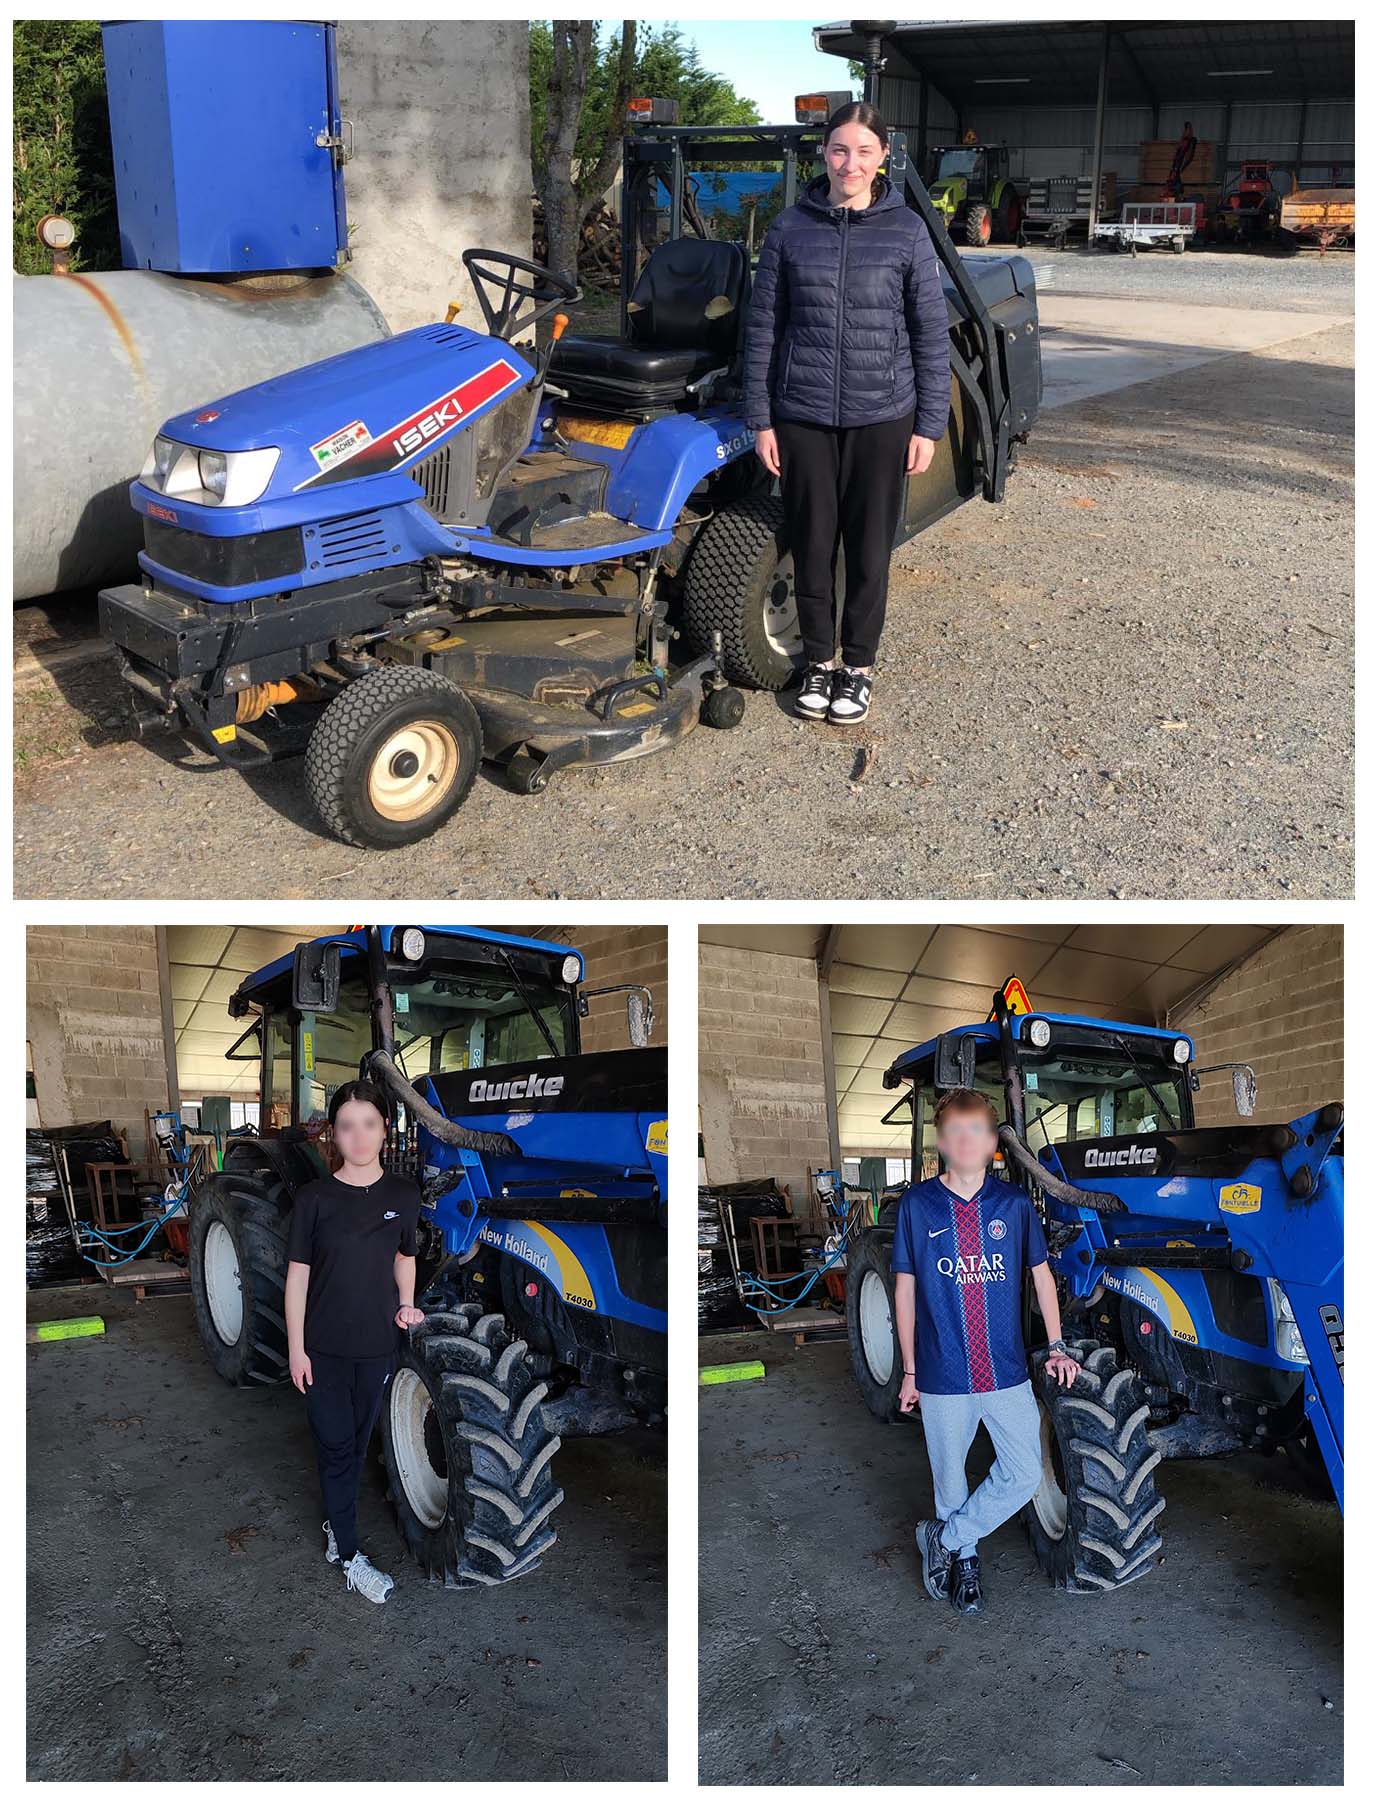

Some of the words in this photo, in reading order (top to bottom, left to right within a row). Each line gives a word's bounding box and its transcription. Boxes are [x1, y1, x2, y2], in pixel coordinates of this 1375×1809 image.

[392, 398, 463, 457] ISEKI
[331, 437, 357, 455] VACHER
[146, 501, 178, 523] ISEKI
[468, 1073, 564, 1102] Quicke
[1084, 1144, 1157, 1168] Quicke
[479, 1226, 503, 1246] New
[504, 1233, 549, 1272] Holland
[937, 1253, 1005, 1278] QATAR
[955, 1270, 1006, 1285] AIRWAYS
[565, 1292, 593, 1309] T4030
[1102, 1271, 1121, 1290] New
[1122, 1279, 1158, 1312] Holland
[1173, 1329, 1196, 1343] T4030
